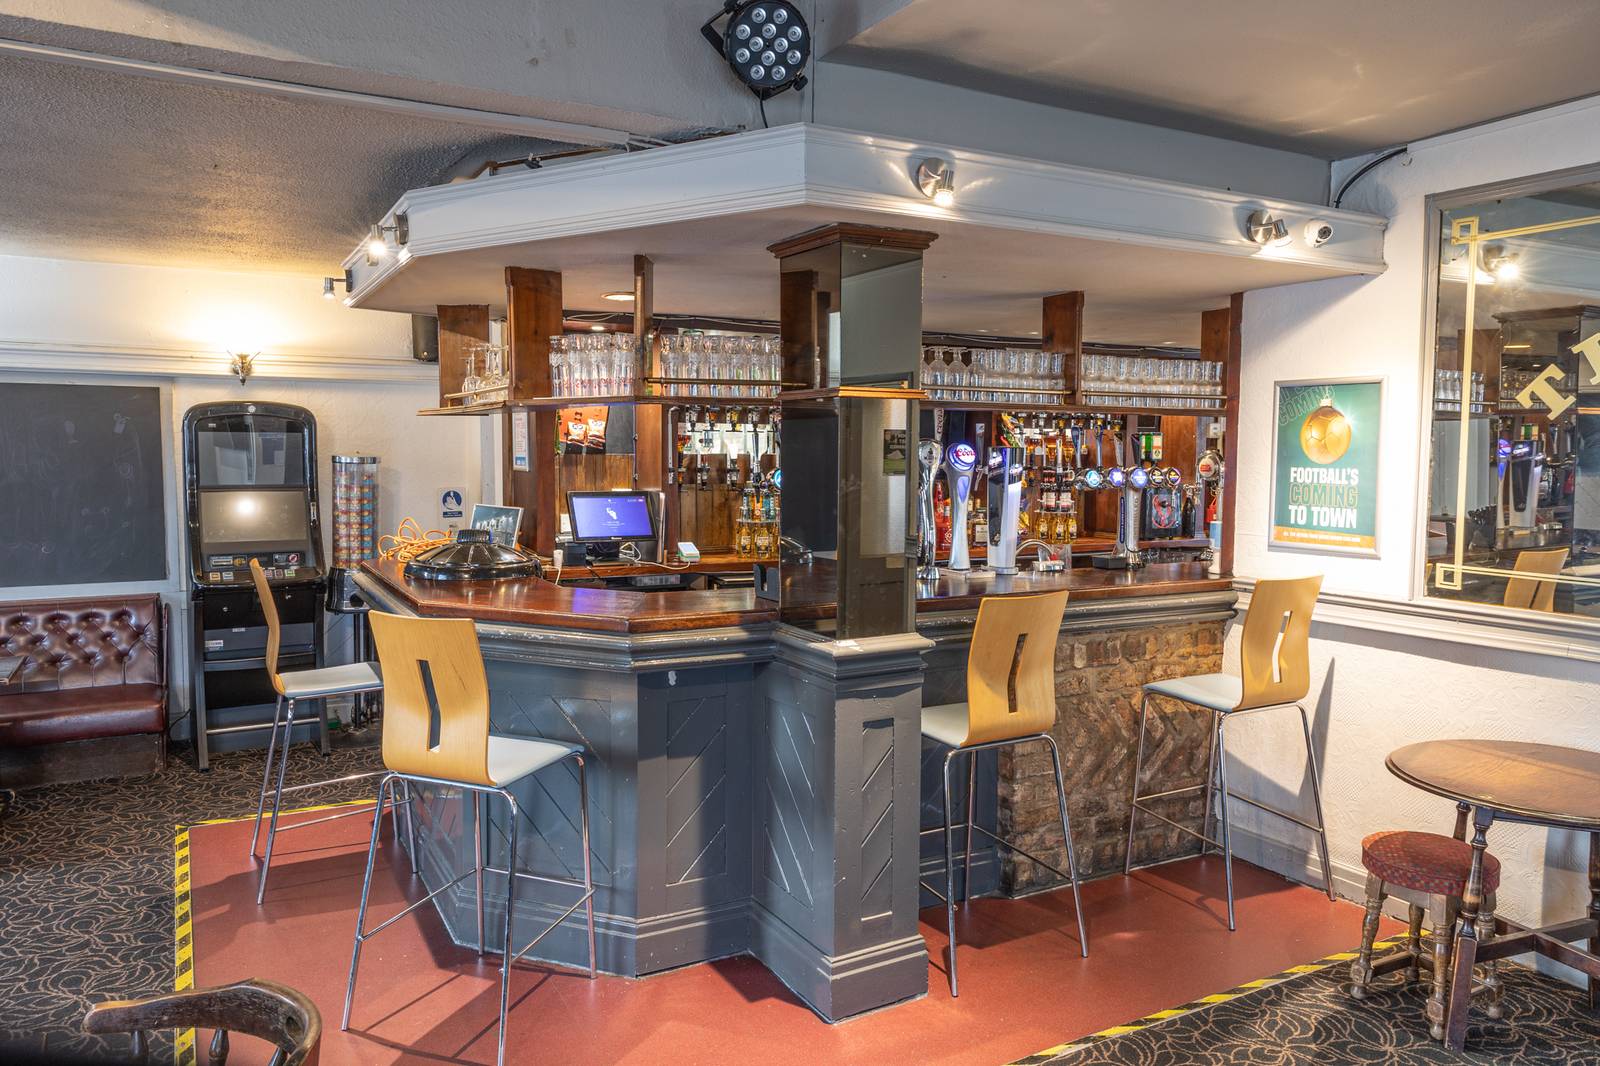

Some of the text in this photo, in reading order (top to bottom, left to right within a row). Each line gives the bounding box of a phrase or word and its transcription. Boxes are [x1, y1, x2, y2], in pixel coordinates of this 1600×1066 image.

[1290, 467, 1360, 485] FOOTBALL'S
[1289, 483, 1360, 508] COMING
[1288, 505, 1358, 528] TO TOWN
